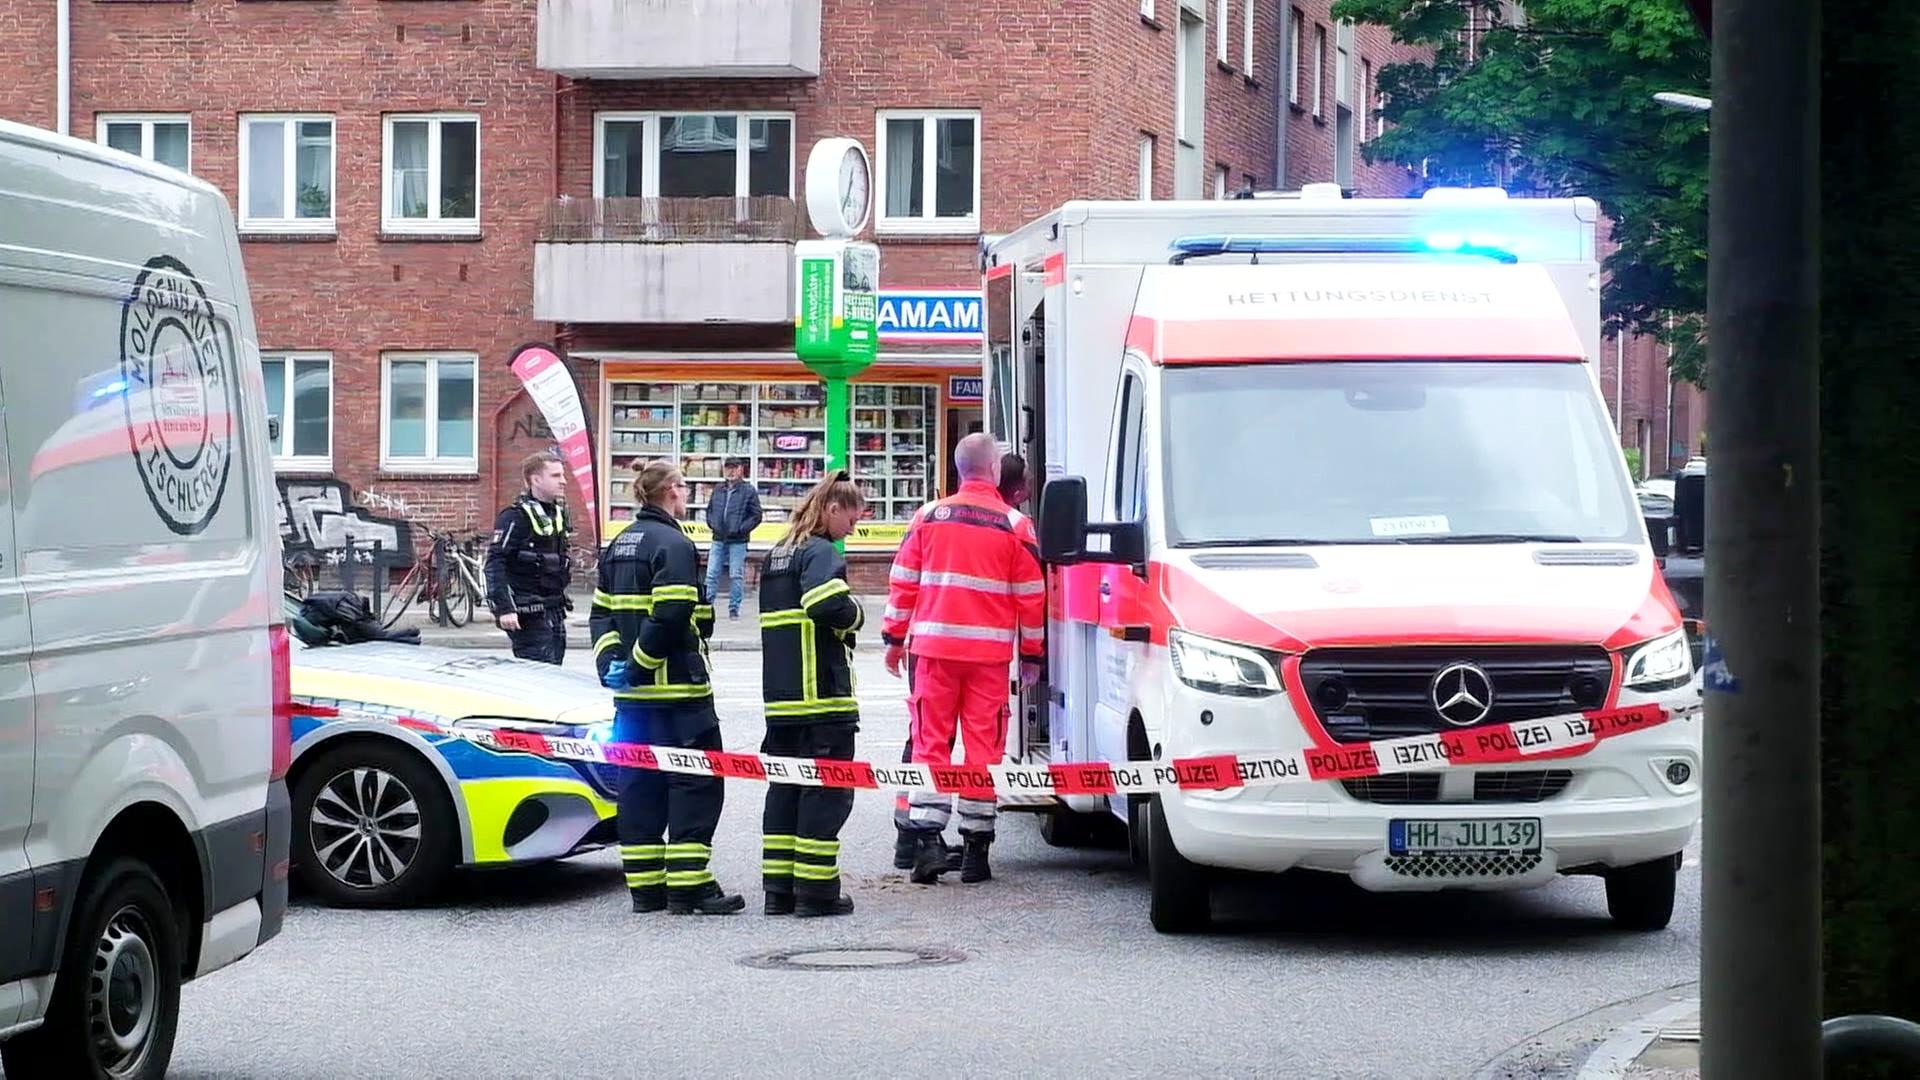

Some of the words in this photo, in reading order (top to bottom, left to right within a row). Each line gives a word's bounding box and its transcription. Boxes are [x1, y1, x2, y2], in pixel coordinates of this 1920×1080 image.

[878, 300, 979, 328] AMAM
[140, 422, 221, 512] TISCHLEREI
[544, 738, 594, 757] POLIZEI
[603, 746, 657, 764] POLIZEI
[668, 751, 723, 771] POLIZEI
[732, 759, 788, 777] POLIZEI
[799, 764, 856, 784] POLIZEI
[867, 768, 925, 786] POLIZEI
[934, 770, 995, 789] POLIZEI
[1006, 771, 1068, 789] POLIZEI
[1080, 769, 1142, 787] POLIZEI
[1154, 765, 1220, 785] POLIZEI
[1234, 759, 1299, 780] POLIZEI
[1310, 749, 1381, 773] POLIZEI
[1393, 739, 1466, 764] POLIZEI
[1479, 727, 1552, 755] POLIZEI
[1407, 823, 1439, 847] HH
